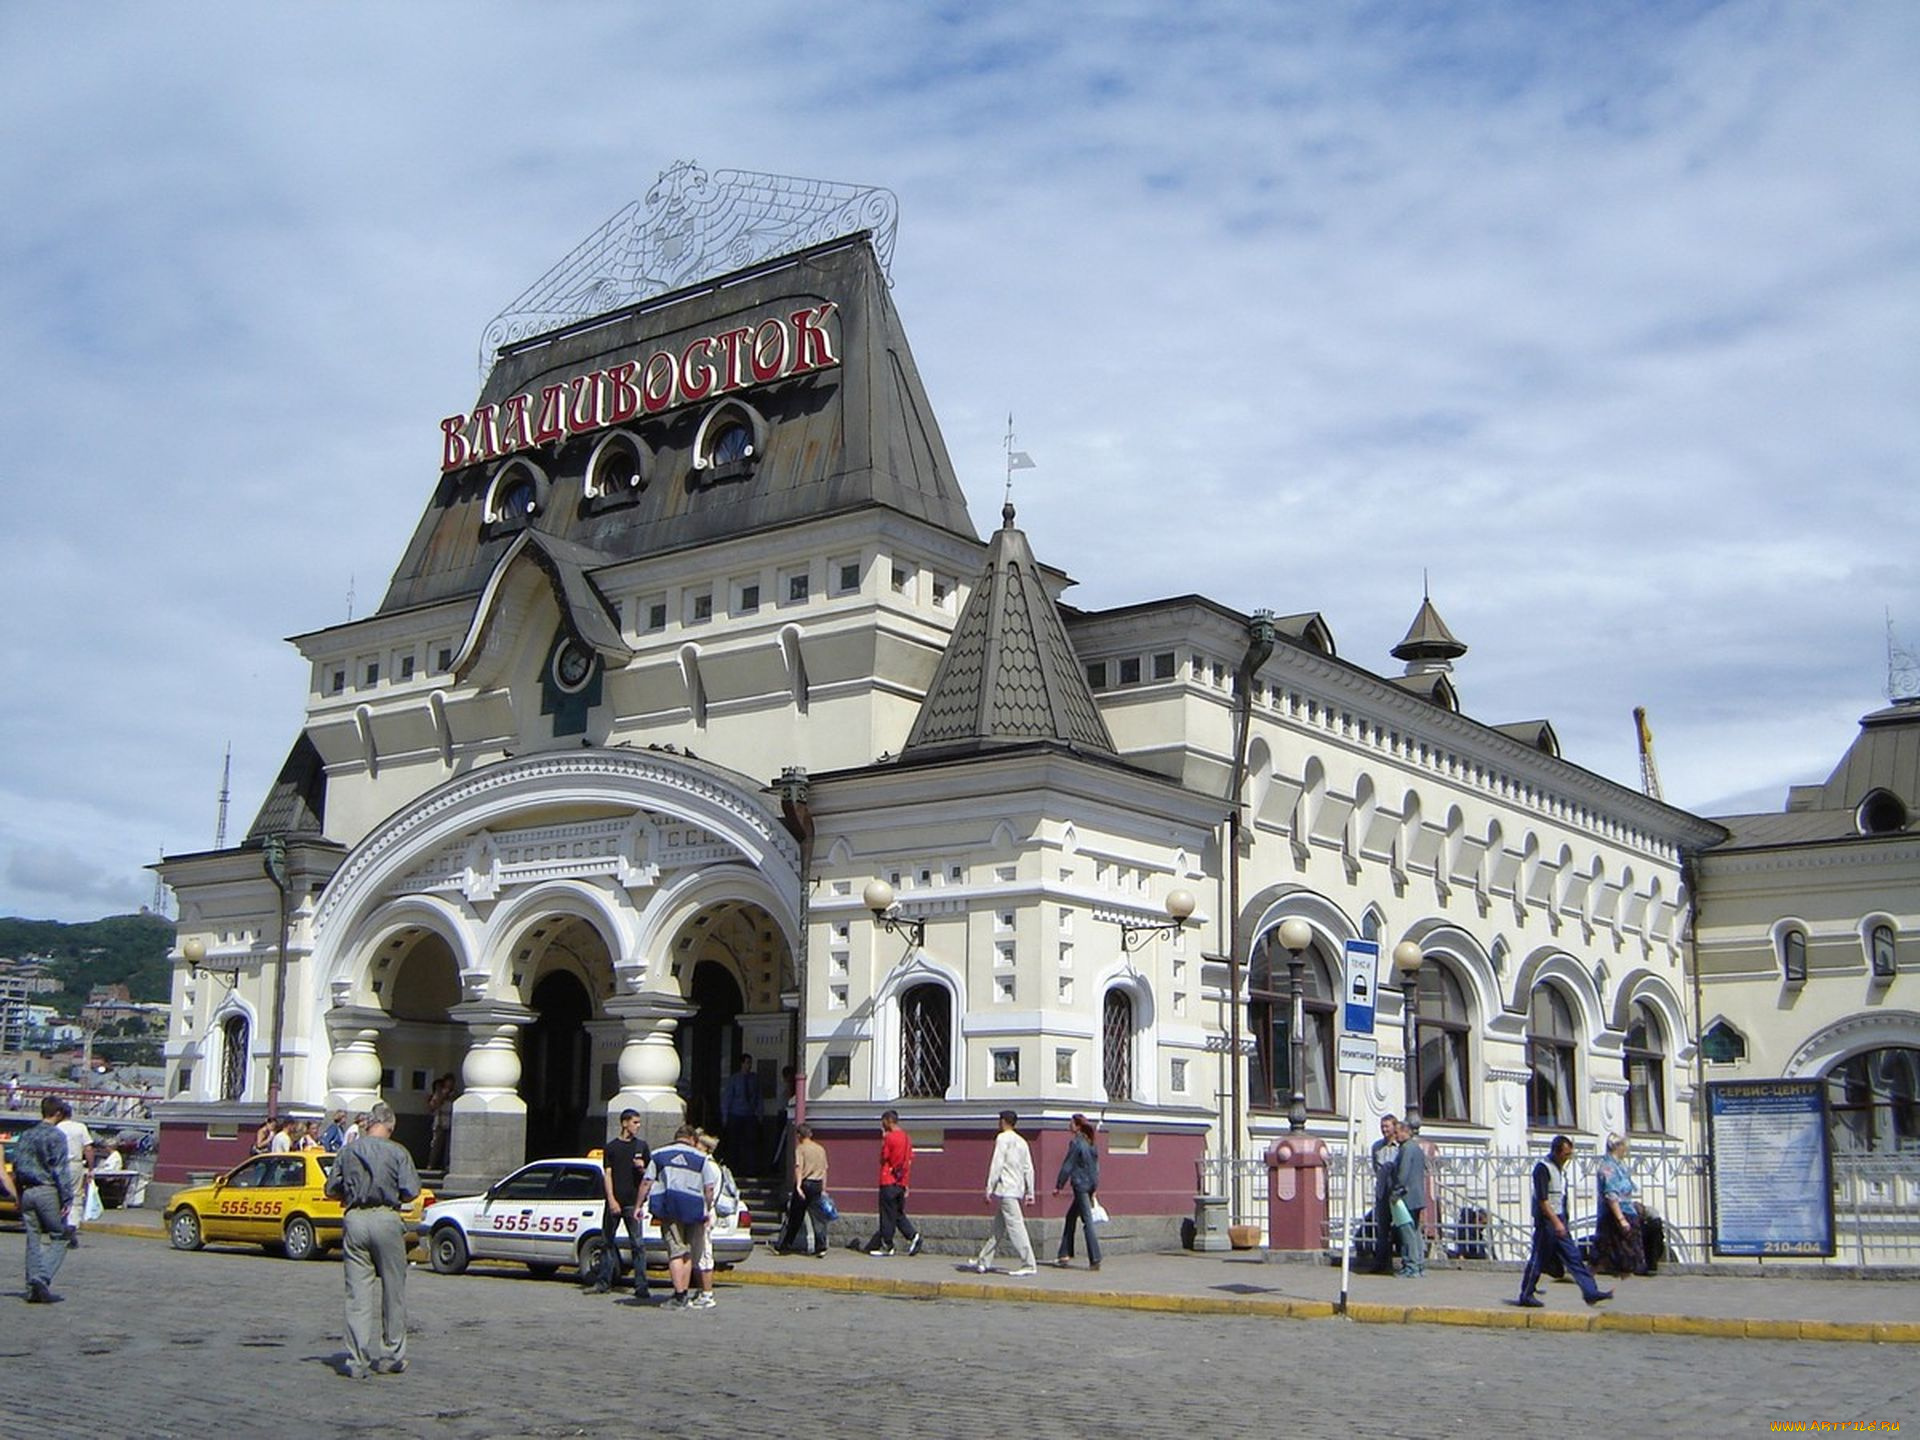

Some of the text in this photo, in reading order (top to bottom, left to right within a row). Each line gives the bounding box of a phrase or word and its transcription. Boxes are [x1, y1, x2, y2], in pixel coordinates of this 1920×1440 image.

[441, 301, 839, 472] ВЛАДИВОСТОК
[1718, 1083, 1817, 1097] СЕРВИС-ЦЕНТР
[220, 1200, 283, 1216] 555-555
[492, 1214, 579, 1233] 555-555
[1763, 1241, 1821, 1253] 210-404
